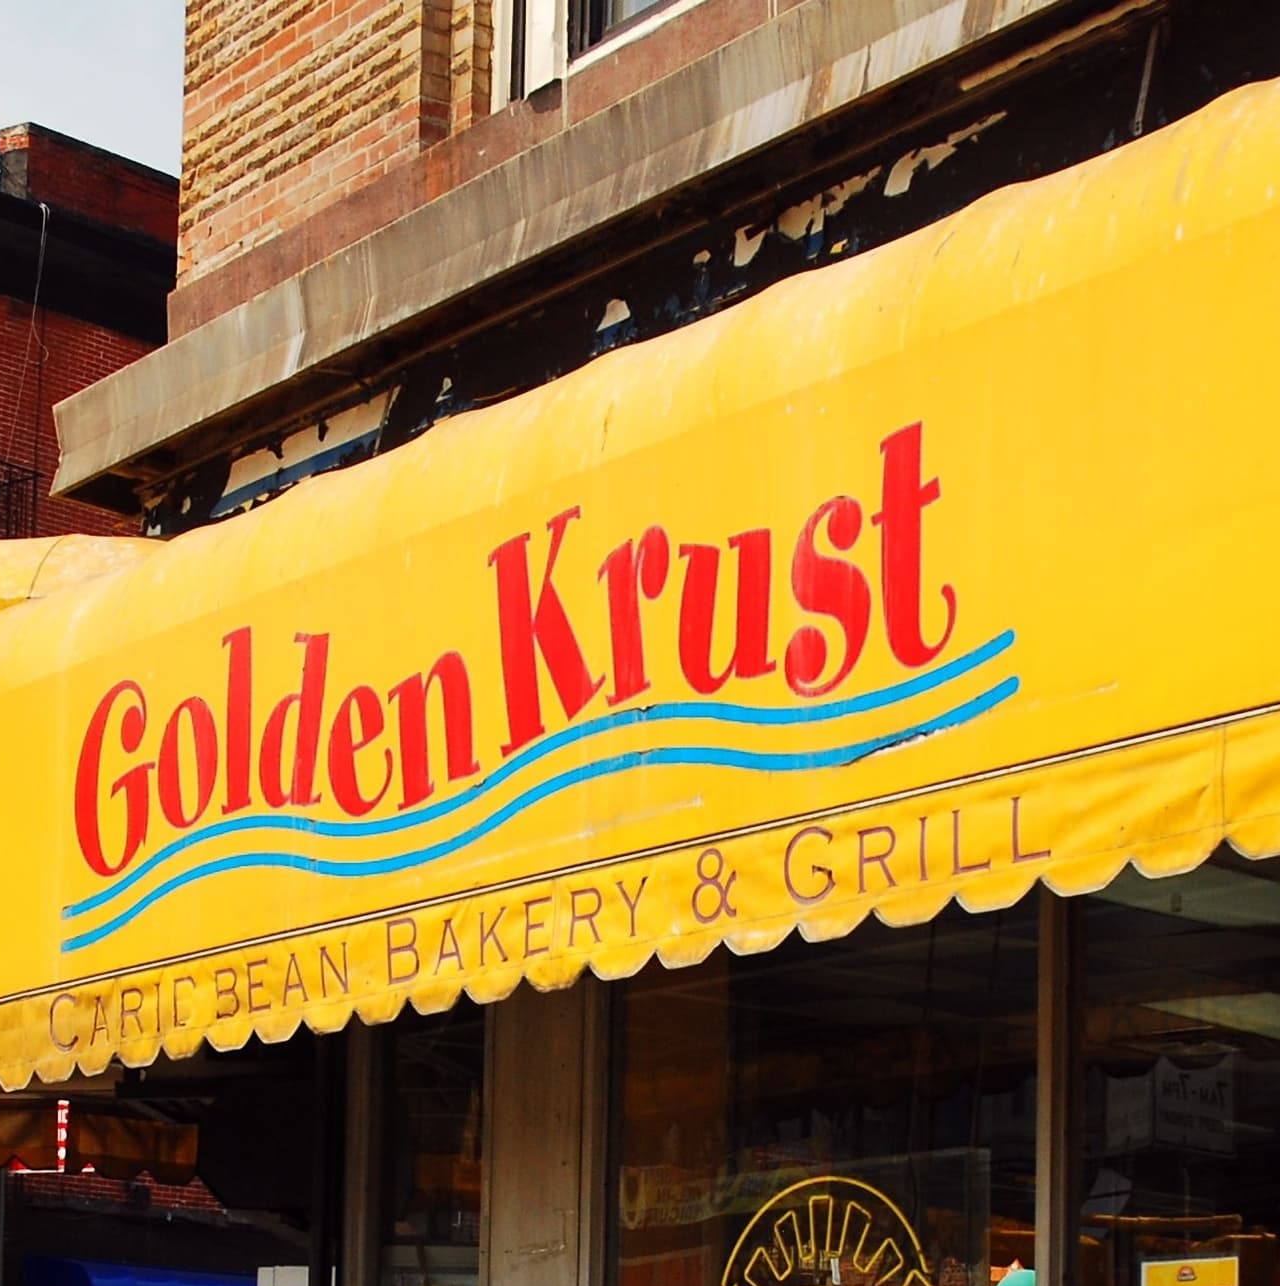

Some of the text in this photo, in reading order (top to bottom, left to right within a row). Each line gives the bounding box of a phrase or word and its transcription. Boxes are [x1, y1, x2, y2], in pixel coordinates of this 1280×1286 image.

[75, 420, 956, 877] Golden Krust
[386, 875, 649, 986] BAKERY
[691, 846, 739, 924] &
[783, 795, 1052, 906] GRILL
